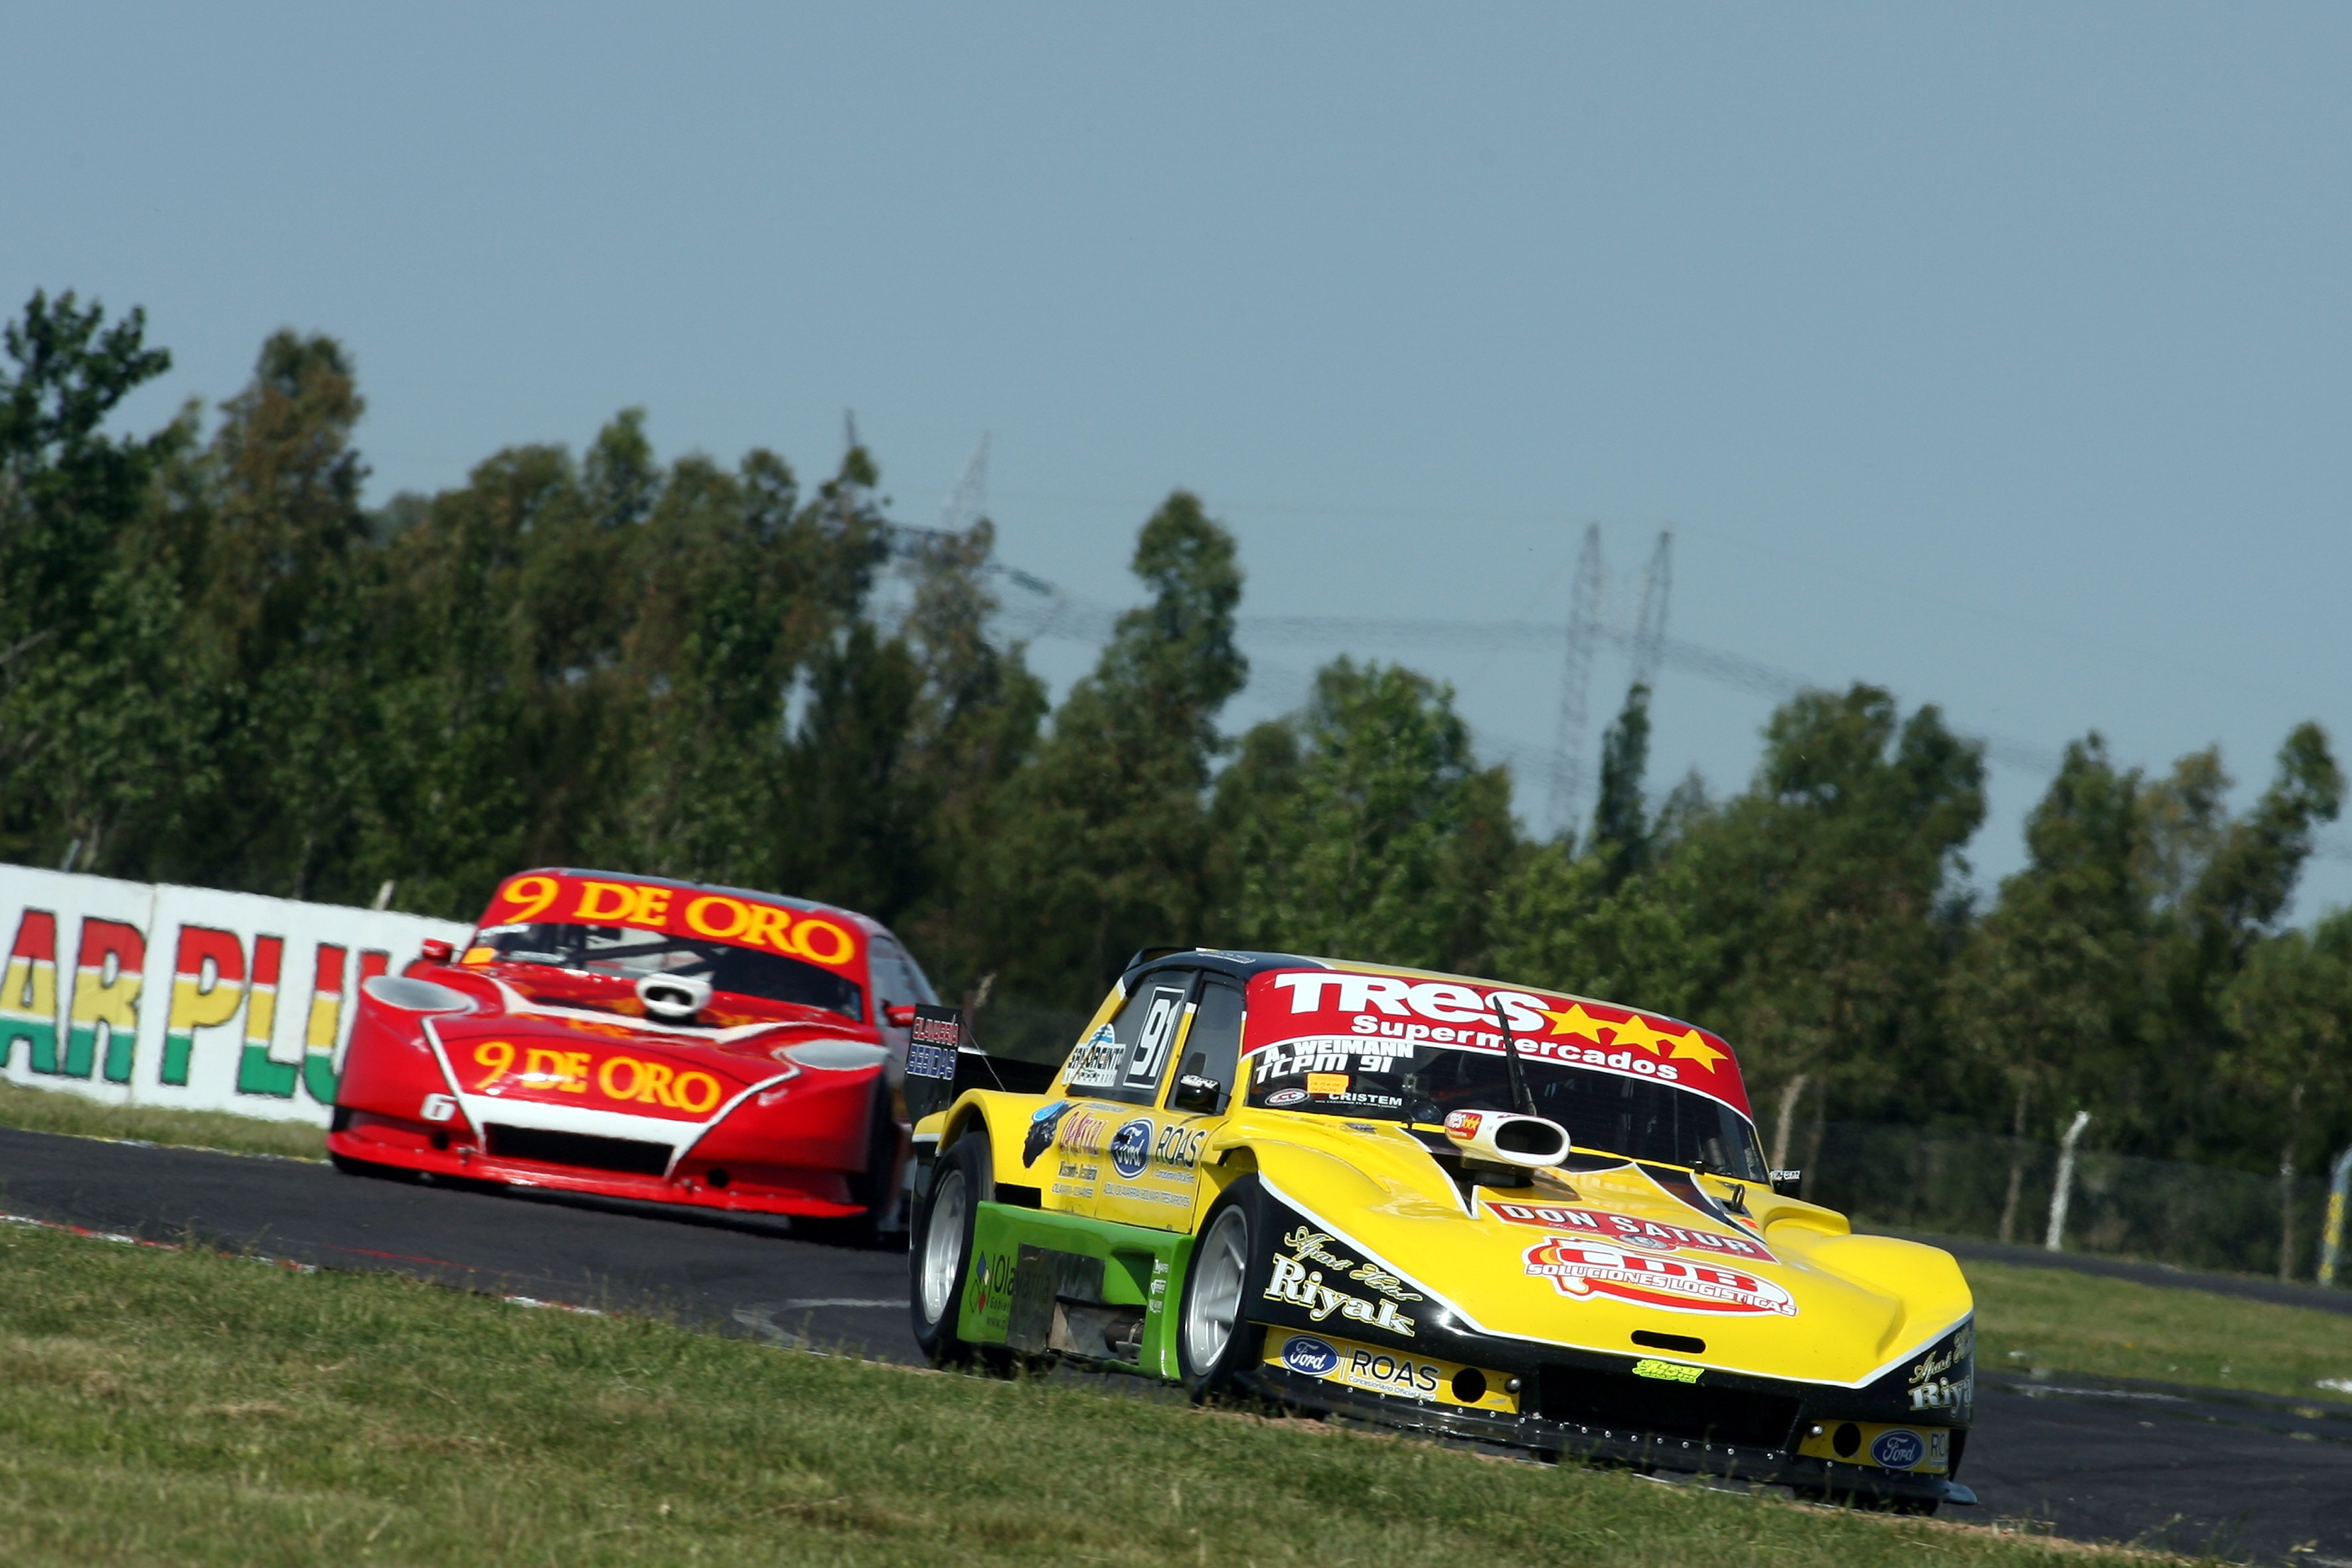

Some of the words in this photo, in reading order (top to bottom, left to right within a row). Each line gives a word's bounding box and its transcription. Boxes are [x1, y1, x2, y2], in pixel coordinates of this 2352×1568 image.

[503, 876, 559, 923] 9
[574, 882, 672, 926] DE
[686, 896, 854, 965] ORO
[1129, 998, 1182, 1077] 91
[1263, 1046, 1287, 1065] A.
[1294, 1040, 1415, 1058] WEIMANN
[1351, 1014, 1679, 1080] Supermercados
[474, 1041, 515, 1089] 9
[520, 1048, 592, 1093] DE
[600, 1056, 722, 1113] ORO
[1358, 1056, 1393, 1073] 91
[1328, 1093, 1403, 1107] CRISTEM
[1155, 1125, 1206, 1168] ROAS
[1500, 1205, 1599, 1228] DON
[1608, 1215, 1757, 1254] SATUR
[1263, 1253, 1415, 1337] Riyak
[1527, 1263, 1668, 1288] SOLUCIONES
[1669, 1281, 1798, 1317] LOGISTICAS
[1289, 1340, 1328, 1370] Ford
[1351, 1350, 1440, 1391] ROAS
[1883, 1436, 1916, 1461] Ford
